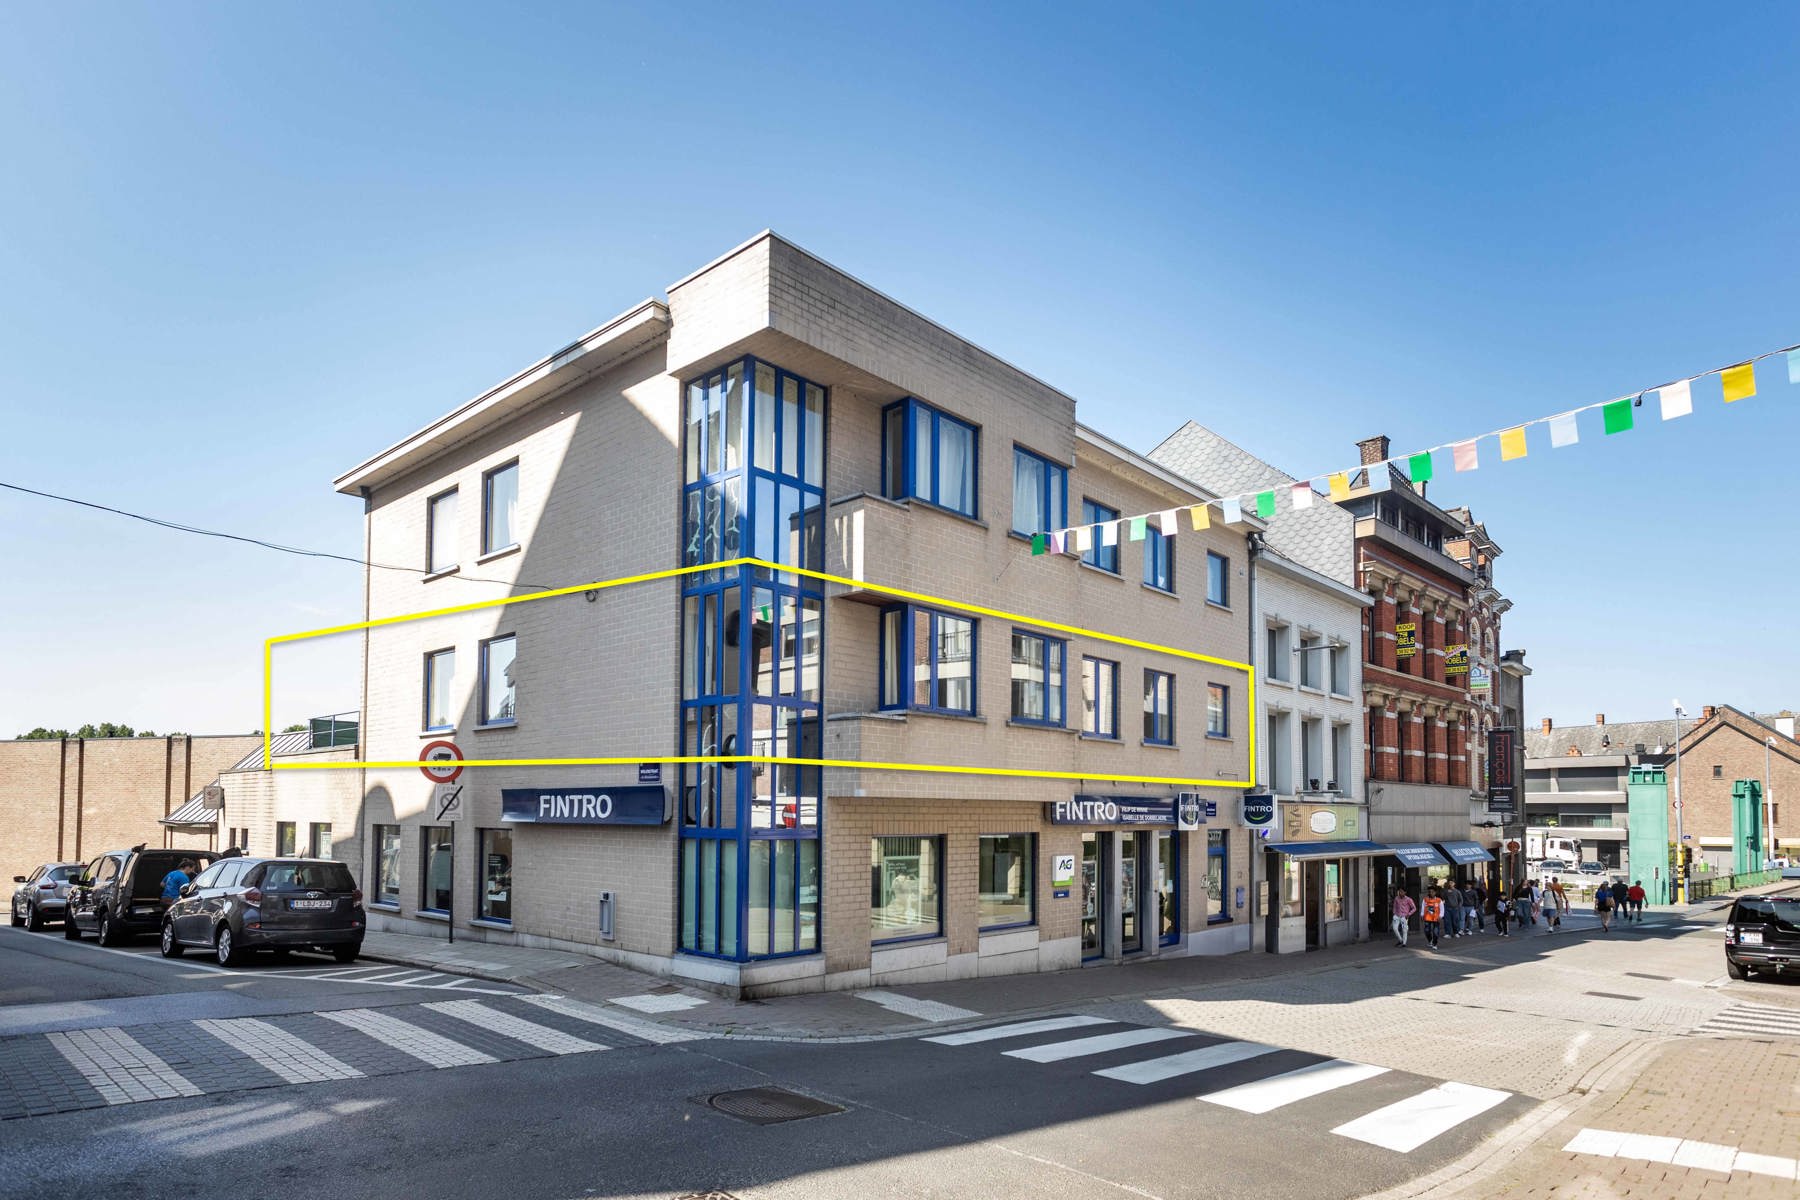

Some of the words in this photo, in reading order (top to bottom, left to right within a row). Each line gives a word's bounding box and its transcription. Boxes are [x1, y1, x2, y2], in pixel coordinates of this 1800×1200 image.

[539, 795, 612, 819] FINTRO
[1055, 801, 1117, 821] FINTRO
[1058, 859, 1072, 870] AG
